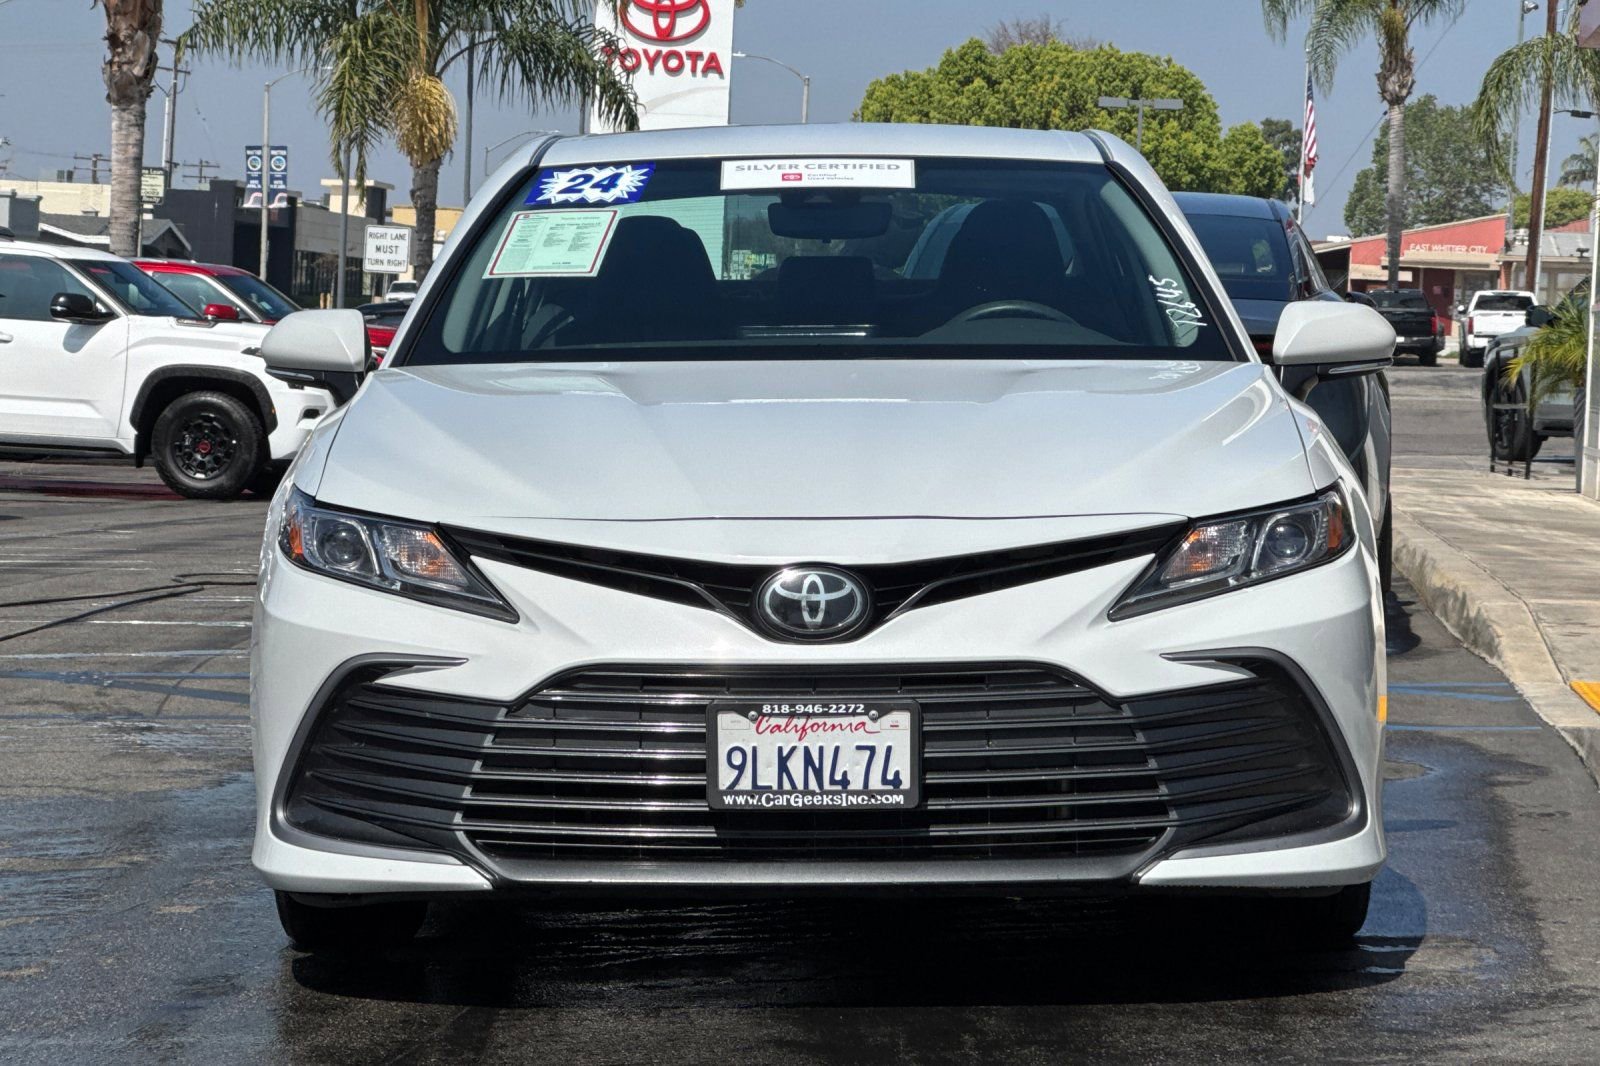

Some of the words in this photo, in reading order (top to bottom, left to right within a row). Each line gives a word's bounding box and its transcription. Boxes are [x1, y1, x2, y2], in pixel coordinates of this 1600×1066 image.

[735, 163, 800, 172] SILVER
[804, 163, 901, 171] CERTIFIED
[556, 172, 625, 194] 24
[368, 232, 388, 240] RIGHT
[390, 233, 407, 241] LANE
[375, 245, 400, 254] MUST
[1409, 243, 1430, 251] EAST
[1431, 244, 1466, 253] WHITTIER
[1468, 245, 1488, 254] CITY
[367, 258, 384, 266] TURN
[387, 259, 406, 267] RIGHT
[762, 703, 865, 714] 818-946-2272
[755, 714, 880, 742] California
[726, 745, 903, 790] 9LKN474
